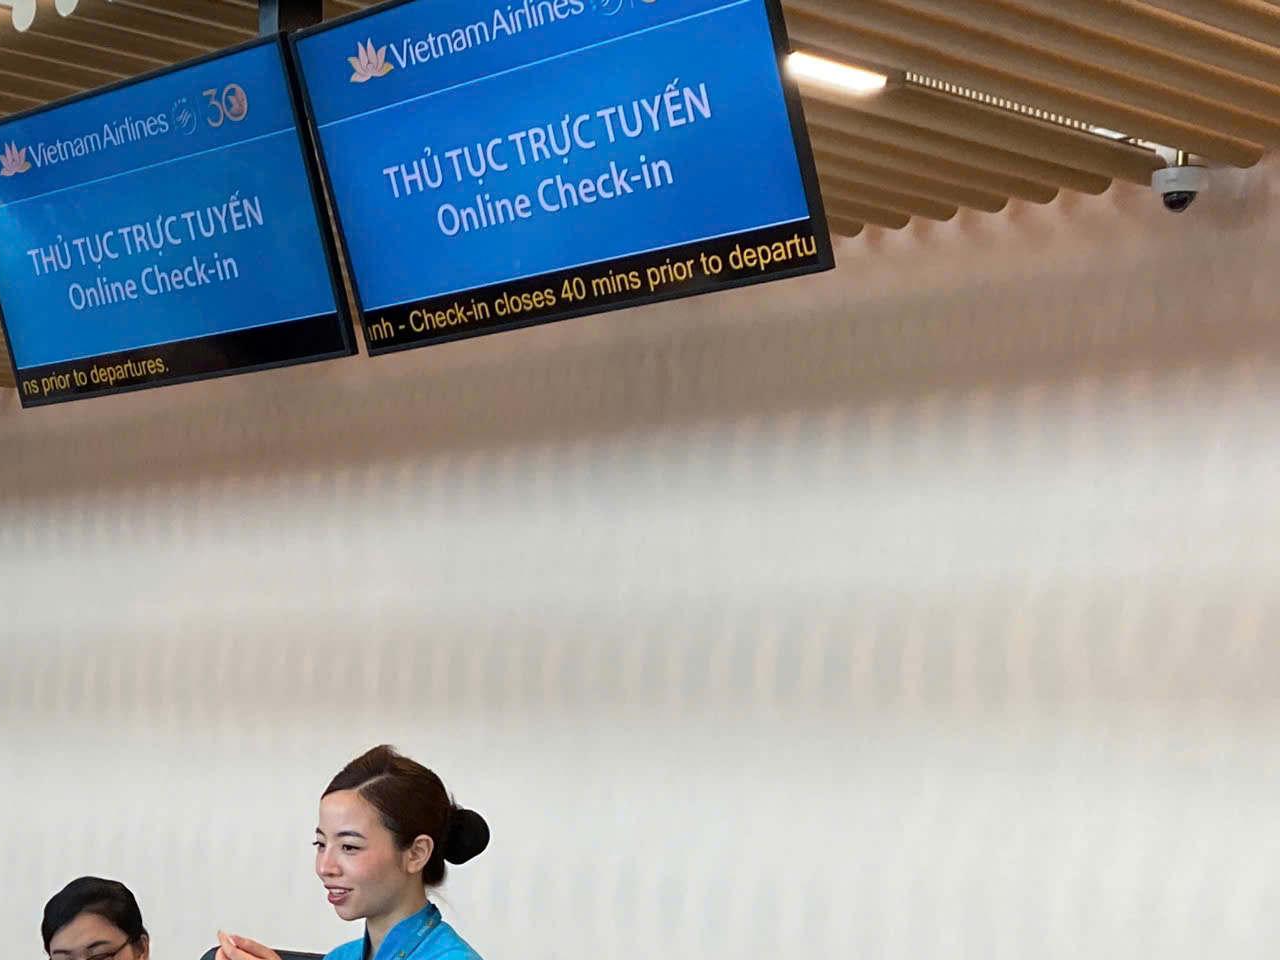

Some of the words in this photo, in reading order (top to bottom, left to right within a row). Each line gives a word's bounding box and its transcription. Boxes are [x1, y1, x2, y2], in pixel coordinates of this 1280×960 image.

[383, 147, 443, 199] THỦ
[445, 137, 508, 186] TỤC
[508, 114, 596, 164] TRỰC
[597, 77, 712, 143] TUYẾN
[27, 235, 70, 276] THỦ
[72, 231, 119, 269] TỤC
[118, 215, 181, 256] TRỰC
[181, 190, 264, 241] TUYẾN
[437, 193, 532, 236] Online
[537, 155, 674, 212] Check-in
[69, 272, 138, 310] Online
[141, 252, 239, 296] Check-in
[409, 298, 490, 333] Check-in
[495, 288, 556, 316] closes
[561, 276, 586, 303] 40
[592, 269, 641, 298] mins
[646, 258, 694, 292] prior
[700, 252, 723, 275] to
[728, 233, 817, 271] departu
[41, 372, 71, 396] prior
[73, 368, 88, 387] to
[90, 357, 169, 385] departures.
